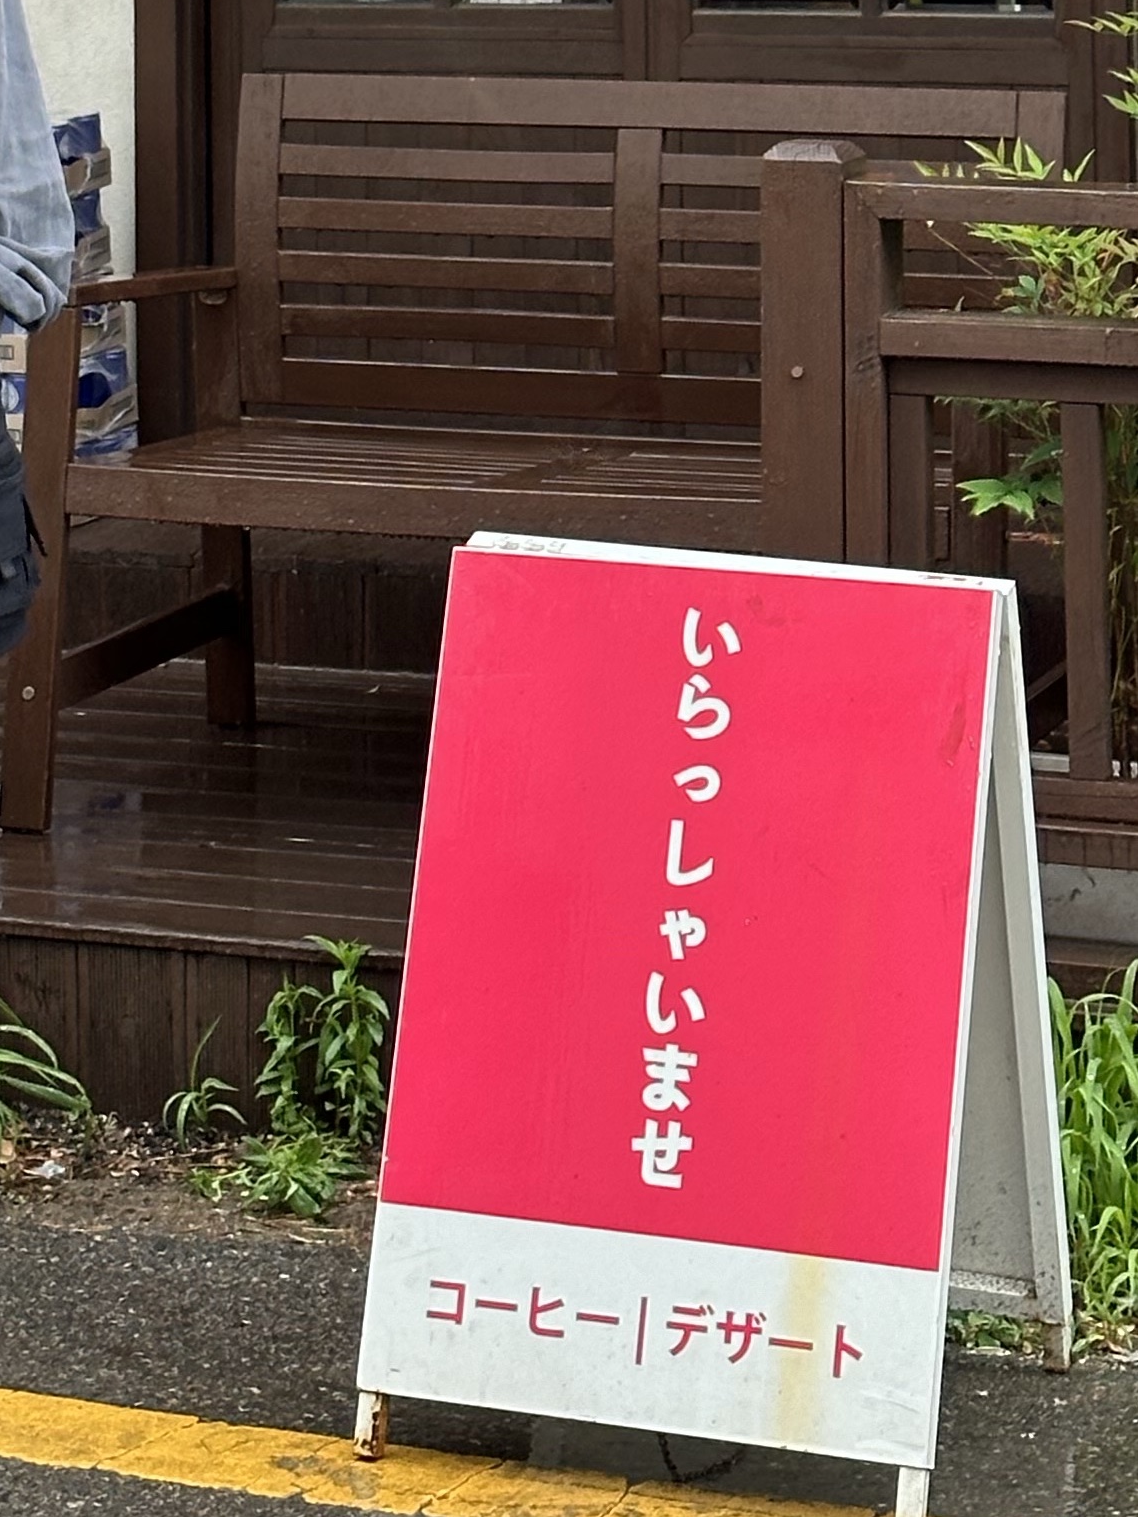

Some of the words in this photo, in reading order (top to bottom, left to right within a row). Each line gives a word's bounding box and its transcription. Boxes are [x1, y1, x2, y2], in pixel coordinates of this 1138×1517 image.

[631, 607, 742, 1190] いらっしゃいませ
